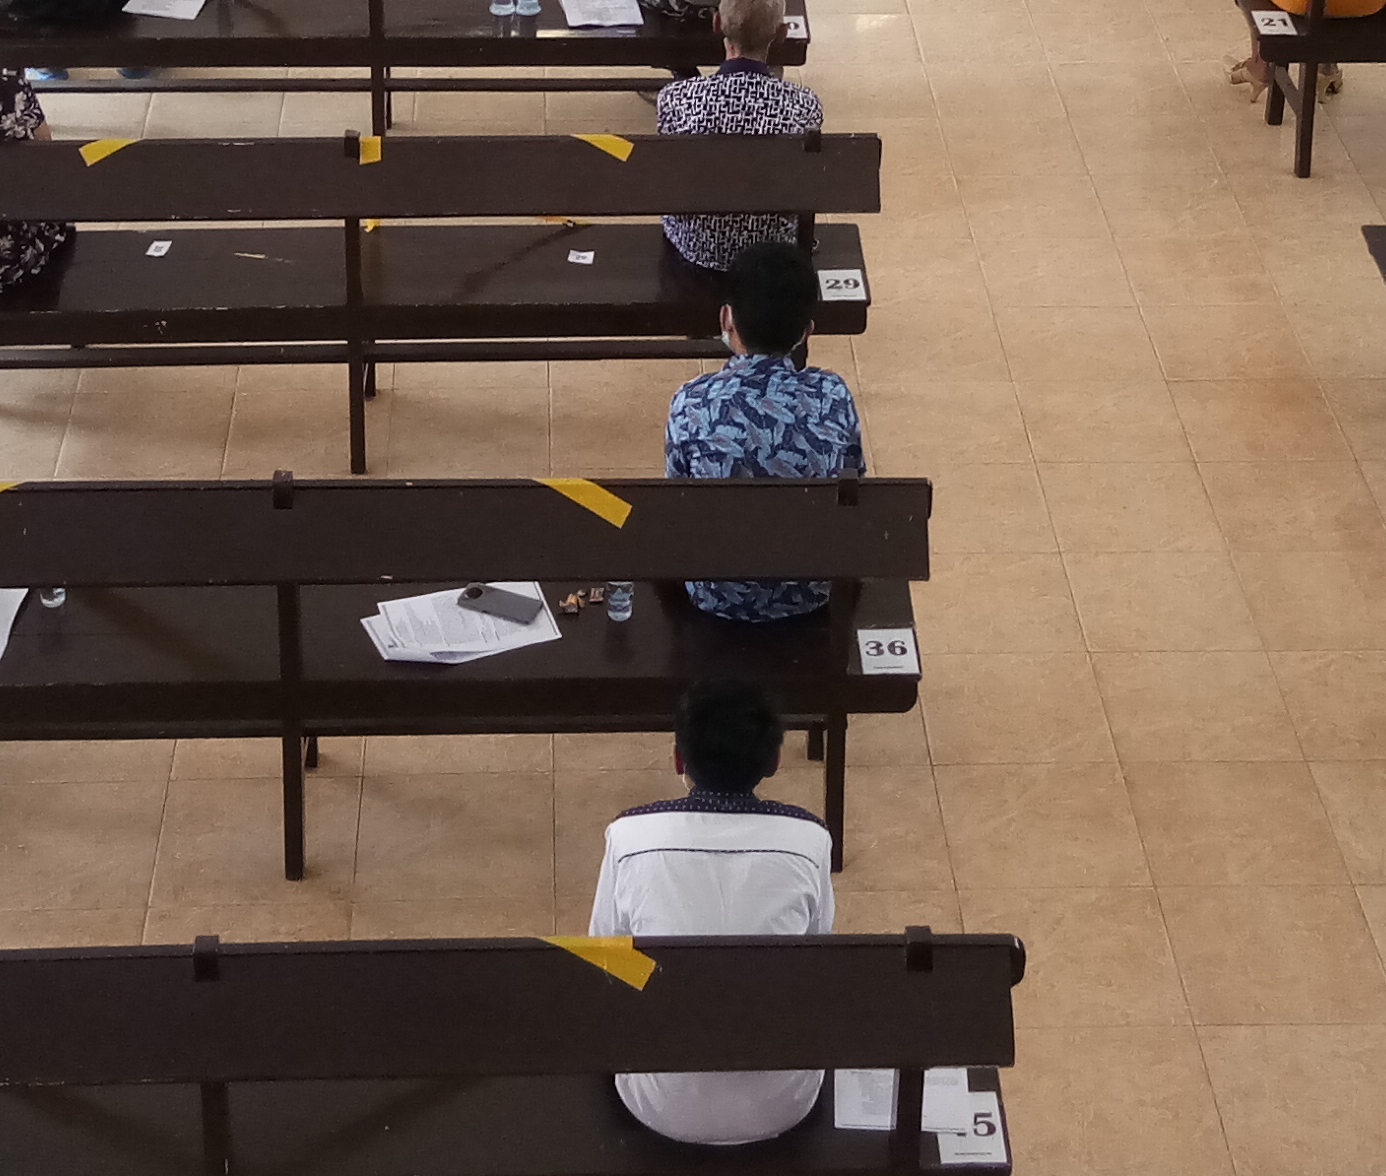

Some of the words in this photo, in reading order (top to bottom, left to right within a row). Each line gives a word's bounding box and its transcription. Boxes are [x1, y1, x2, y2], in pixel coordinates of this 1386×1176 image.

[1261, 16, 1289, 27] 21
[824, 278, 861, 291] 29
[863, 640, 908, 657] 36
